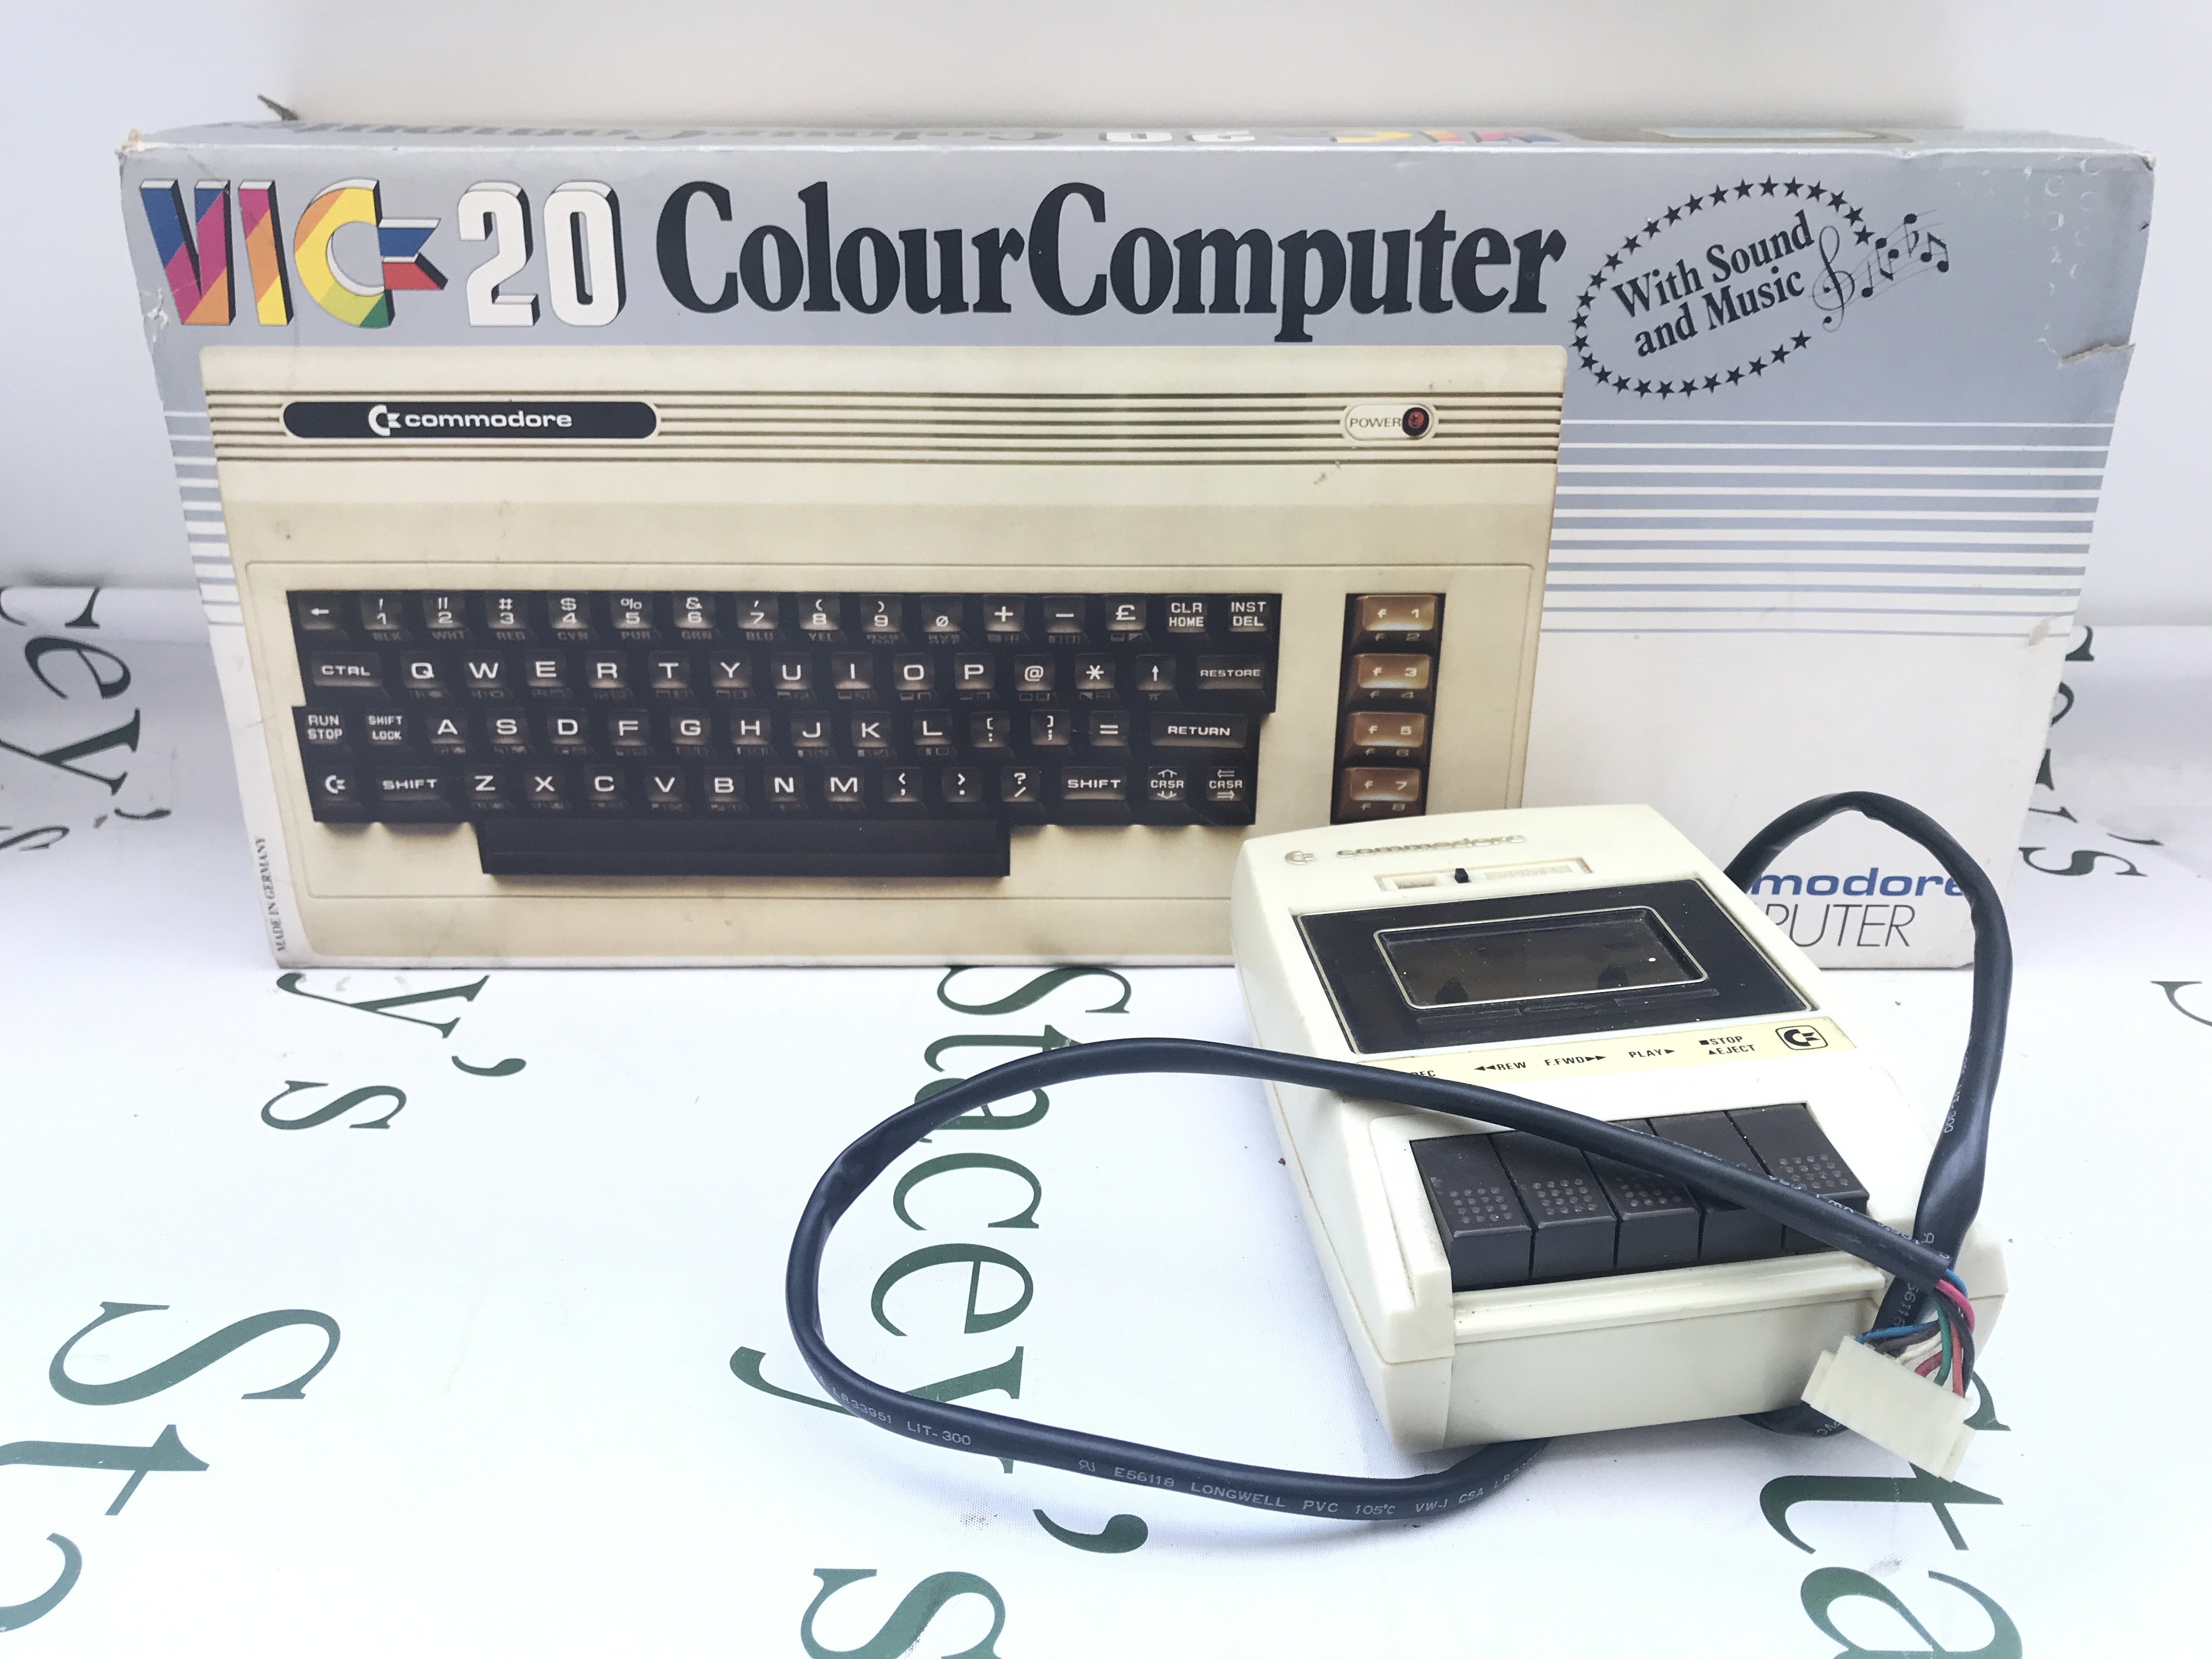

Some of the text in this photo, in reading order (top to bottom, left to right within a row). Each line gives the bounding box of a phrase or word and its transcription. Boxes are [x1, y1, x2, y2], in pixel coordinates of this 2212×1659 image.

[1611, 210, 1815, 318] With Sound
[1635, 266, 1805, 357] and Music
[405, 410, 572, 428] commodore
[1350, 417, 1402, 428] POWER
[1171, 602, 1203, 613] CLR
[1231, 601, 1266, 612] INST
[377, 612, 387, 625] 1
[437, 611, 453, 624] 2
[500, 612, 514, 625] 3
[560, 612, 578, 625] 4
[625, 612, 640, 625] 5
[687, 611, 702, 625] 6
[749, 612, 766, 625] 7
[812, 613, 827, 627] 8
[874, 615, 888, 627] 9
[1169, 616, 1204, 627] HOME
[1233, 616, 1264, 627] DEL
[321, 665, 370, 676] CTRL
[411, 662, 435, 679] Q
[469, 662, 499, 679] W
[535, 661, 557, 678] E
[596, 663, 618, 679] R
[658, 663, 679, 679] T
[720, 662, 740, 678] Y
[782, 664, 802, 681] U
[850, 663, 855, 679] I
[904, 664, 924, 681] O
[964, 664, 984, 680] P
[1024, 665, 1044, 681] @
[308, 714, 339, 726] RUN
[368, 715, 402, 726] SHIFT
[437, 719, 458, 735] A
[496, 719, 517, 735] S
[557, 719, 578, 735] D
[618, 720, 638, 736] F
[680, 719, 701, 736] G
[741, 720, 760, 736] H
[923, 720, 943, 736] L
[308, 728, 342, 740] STOP
[372, 731, 402, 741] LOCK
[802, 722, 821, 738] J
[861, 723, 880, 738] K
[1167, 725, 1230, 736] RETURN
[382, 778, 437, 790] SHIFT
[475, 775, 495, 791] Z
[534, 776, 555, 792] X
[594, 776, 614, 792] C
[654, 777, 675, 793] V
[714, 777, 734, 793] B
[774, 777, 794, 793] N
[830, 777, 858, 793] M
[1068, 779, 1121, 788] SHIFT
[1150, 780, 1184, 789] CRSR
[1209, 780, 1243, 789] CRSR
[1337, 835, 1526, 857] commodore
[1751, 867, 1963, 896] modor
[255, 836, 286, 951] MADE IN GERMANY
[1765, 904, 1915, 947] PUTER
[1709, 1035, 1743, 1046] STOP
[1628, 1048, 1664, 1059] PLAY
[1716, 1045, 1756, 1055] EJECT
[1497, 1062, 1527, 1070] REW
[1544, 1057, 1586, 1066] F.FWD
[833, 1387, 892, 1424] LR33951
[1114, 1466, 1175, 1487] E56118
[1190, 1482, 1286, 1508] LONGWELL
[1302, 1500, 1339, 1513] PVC
[1458, 1487, 1484, 1504] CSA
